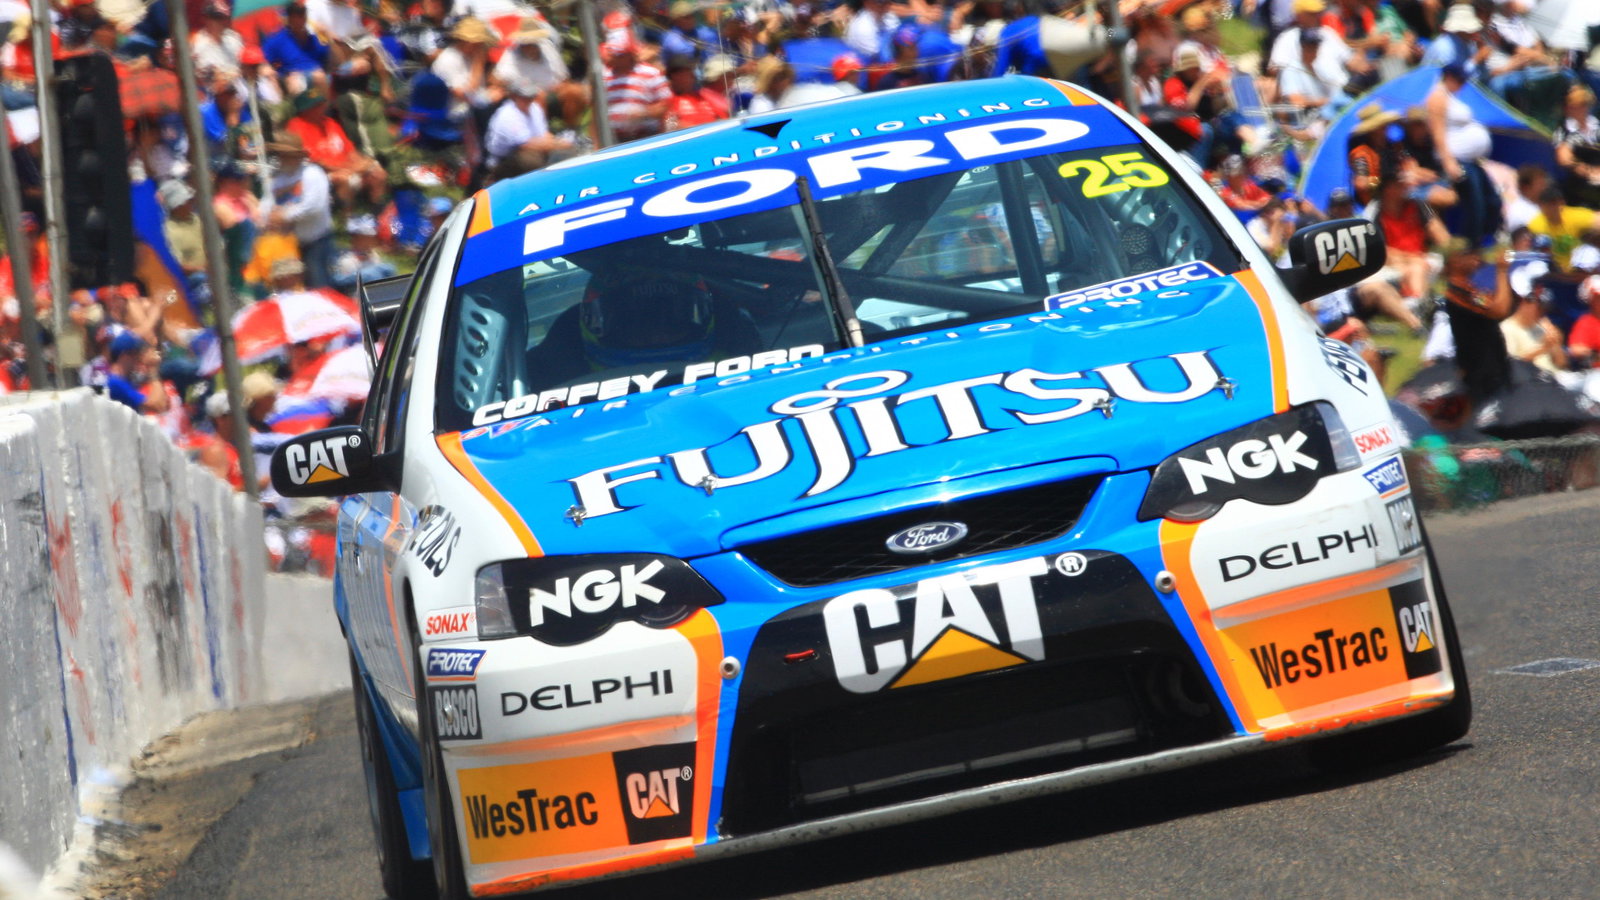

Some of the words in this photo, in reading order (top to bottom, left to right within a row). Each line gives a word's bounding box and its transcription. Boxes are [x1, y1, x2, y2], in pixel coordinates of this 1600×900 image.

[518, 185, 602, 216] AIR
[632, 97, 1052, 185] CONDITIONING
[1057, 151, 1170, 198] 25
[522, 118, 1090, 256] FORD
[1314, 224, 1368, 275] CAT
[1057, 265, 1209, 309] PROTEC
[472, 369, 668, 427] COFFEY
[683, 343, 824, 386] FORD
[565, 349, 1213, 519] FUJITSU
[1355, 427, 1393, 454] SONAX
[285, 436, 350, 486] CAT
[1177, 430, 1319, 495] NGK
[904, 525, 950, 548] Ford
[1218, 522, 1379, 582] DELPHI
[529, 559, 667, 628] NGK
[426, 612, 470, 636] SONAX
[822, 555, 1049, 694] CAT
[1399, 601, 1435, 653] CAT
[429, 652, 482, 673] PROTEC
[1250, 626, 1389, 690] WesTrac
[501, 669, 674, 717] DELPHI
[465, 788, 599, 840] WesTrac
[625, 767, 680, 819] CAT
